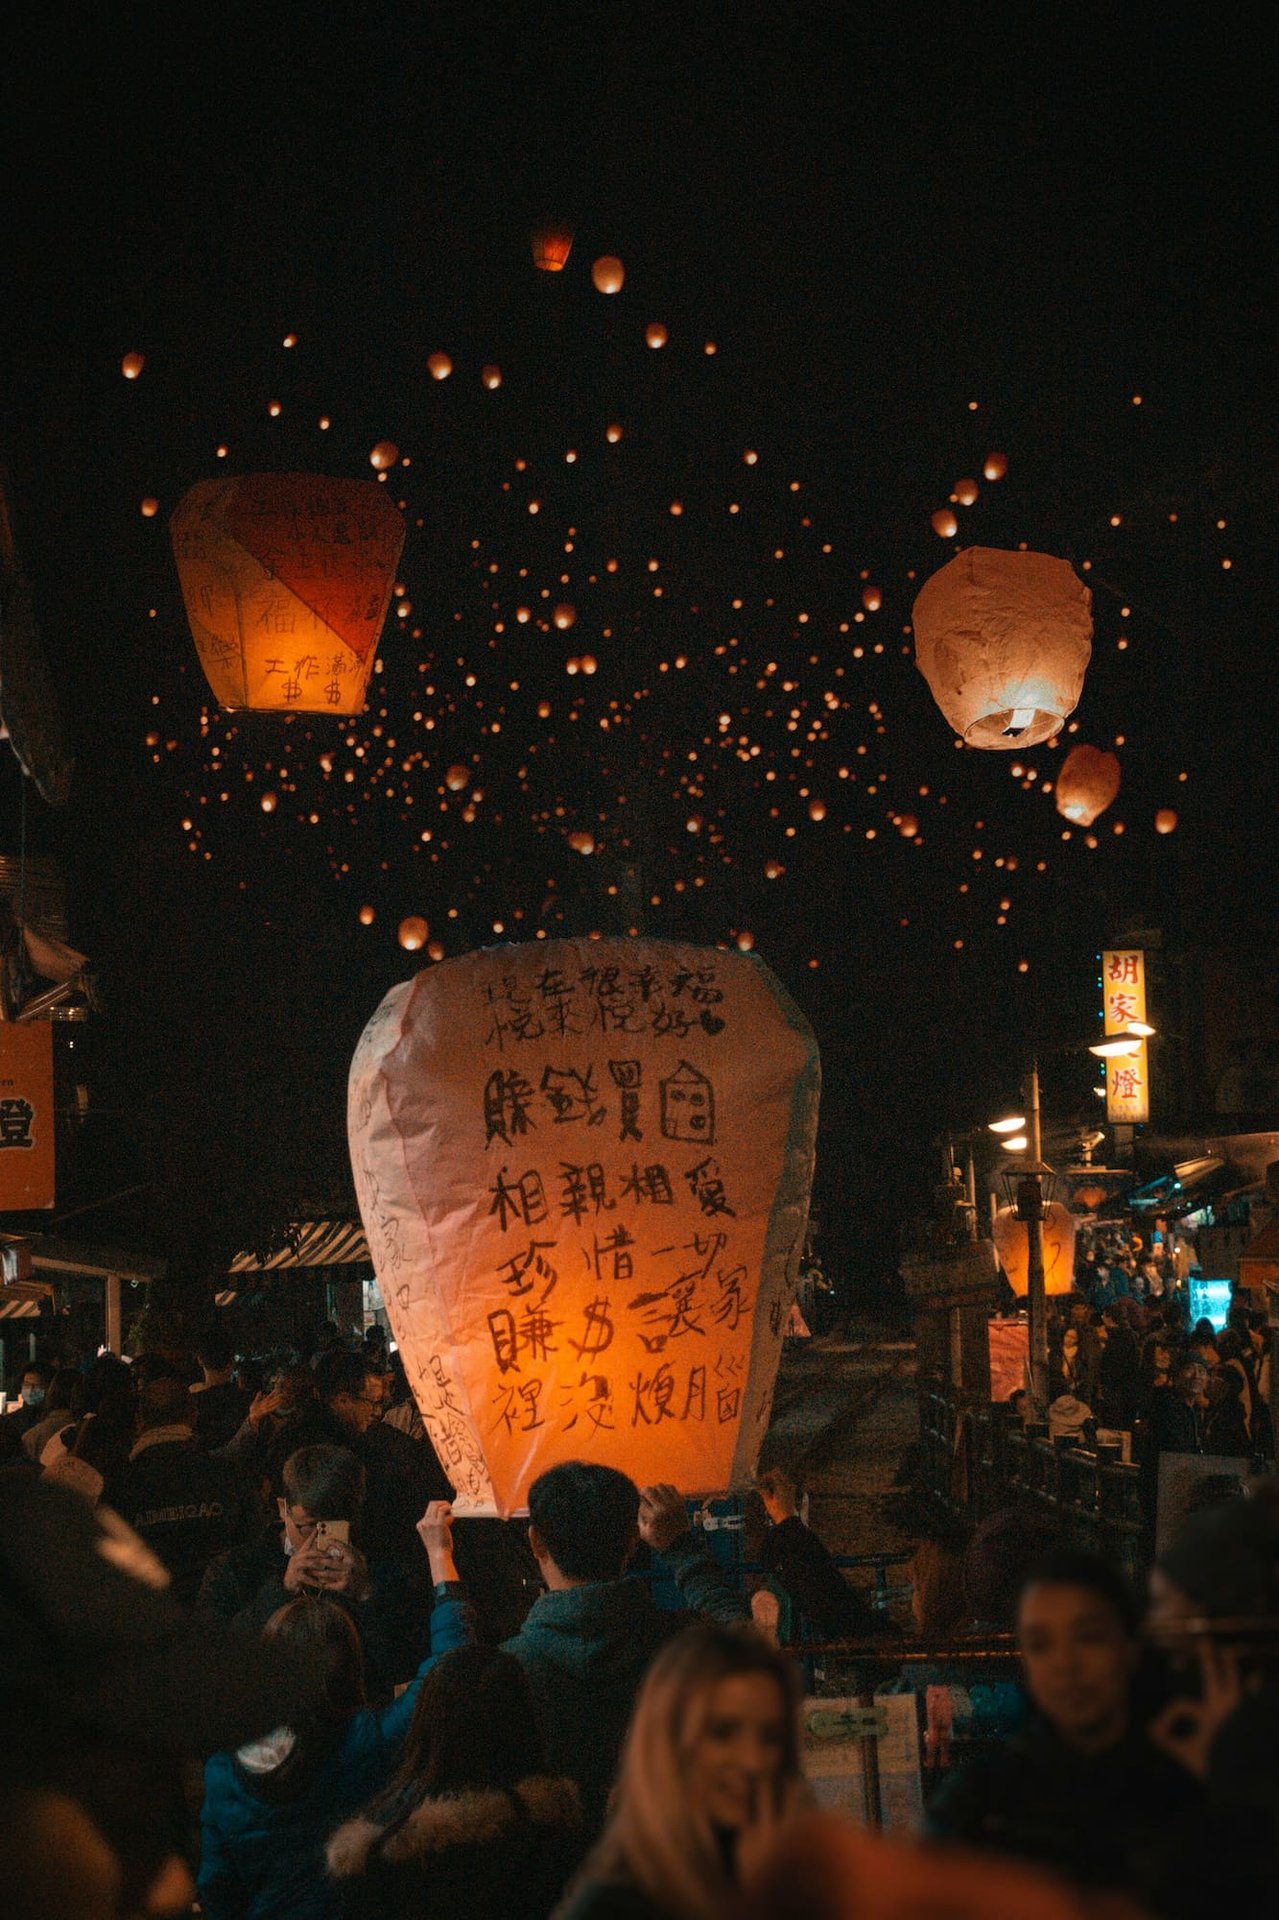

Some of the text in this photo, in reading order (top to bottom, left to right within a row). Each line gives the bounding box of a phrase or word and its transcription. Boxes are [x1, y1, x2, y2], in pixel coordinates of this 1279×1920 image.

[1108, 953, 1143, 1100] 胡家燈
[487, 1158, 738, 1233] 相親相愛
[495, 1222, 729, 1300] 珍惜一切
